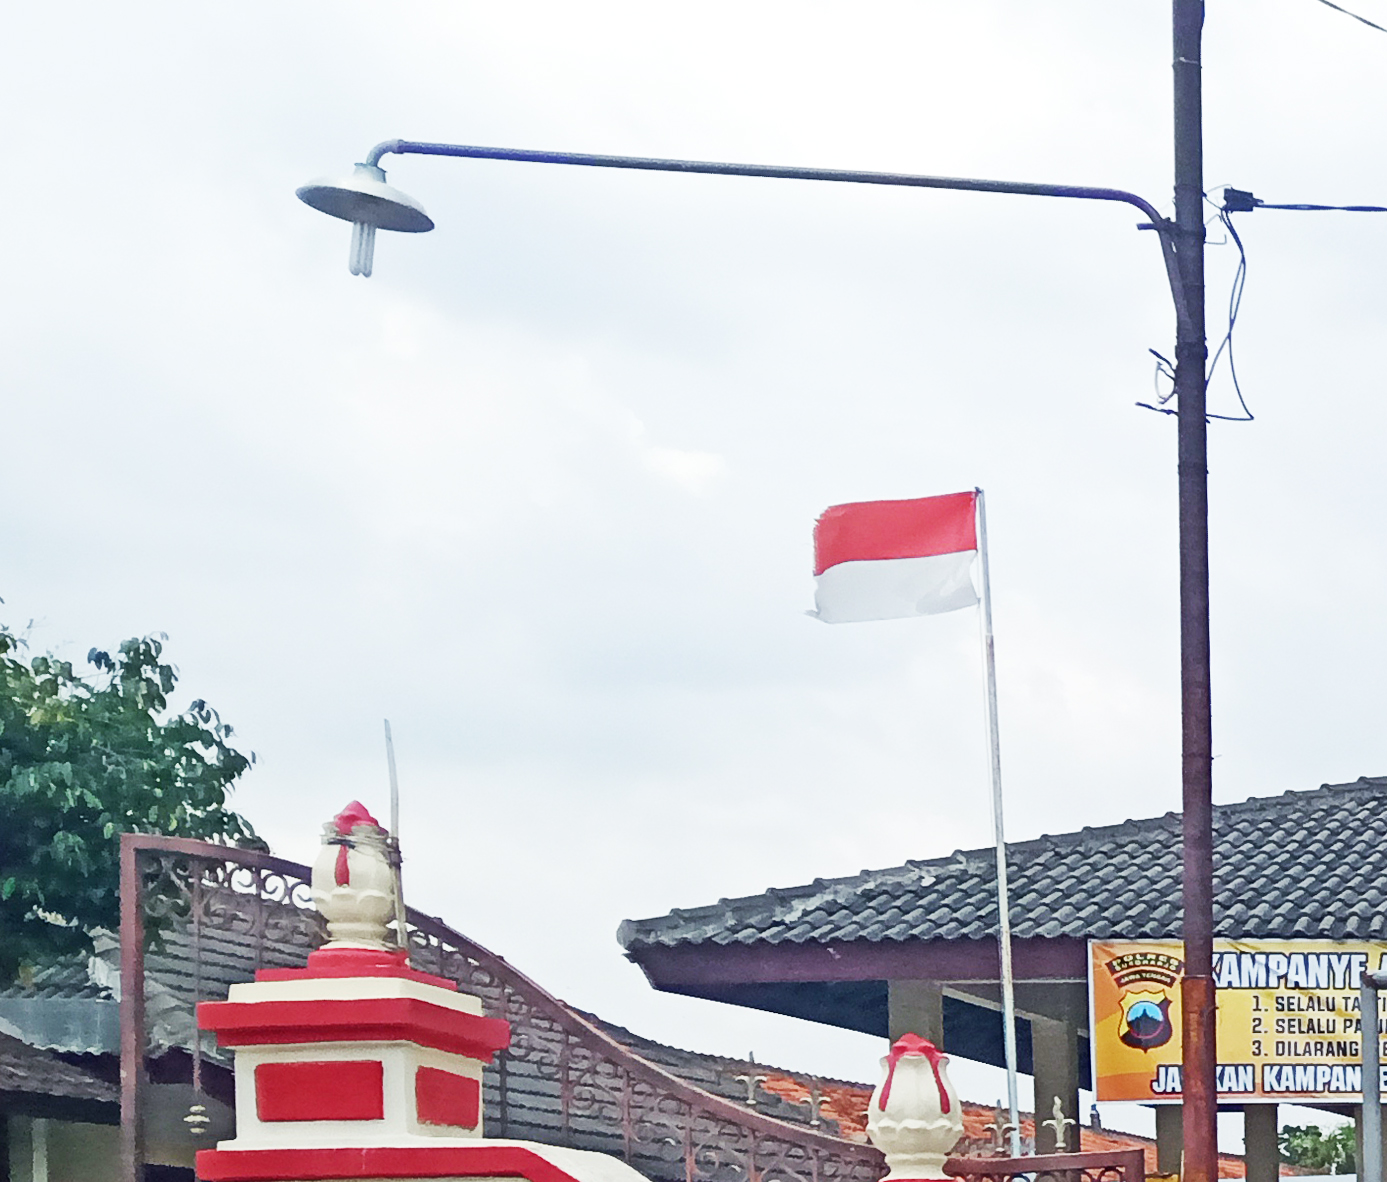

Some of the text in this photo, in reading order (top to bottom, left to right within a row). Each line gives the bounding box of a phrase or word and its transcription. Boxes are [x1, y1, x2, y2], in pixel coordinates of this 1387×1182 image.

[1252, 996, 1336, 1012] 1. SELALU
[1252, 1018, 1336, 1035] 2. SELALU
[1252, 1040, 1268, 1057] 3.
[1275, 1040, 1359, 1057] DILARANG
